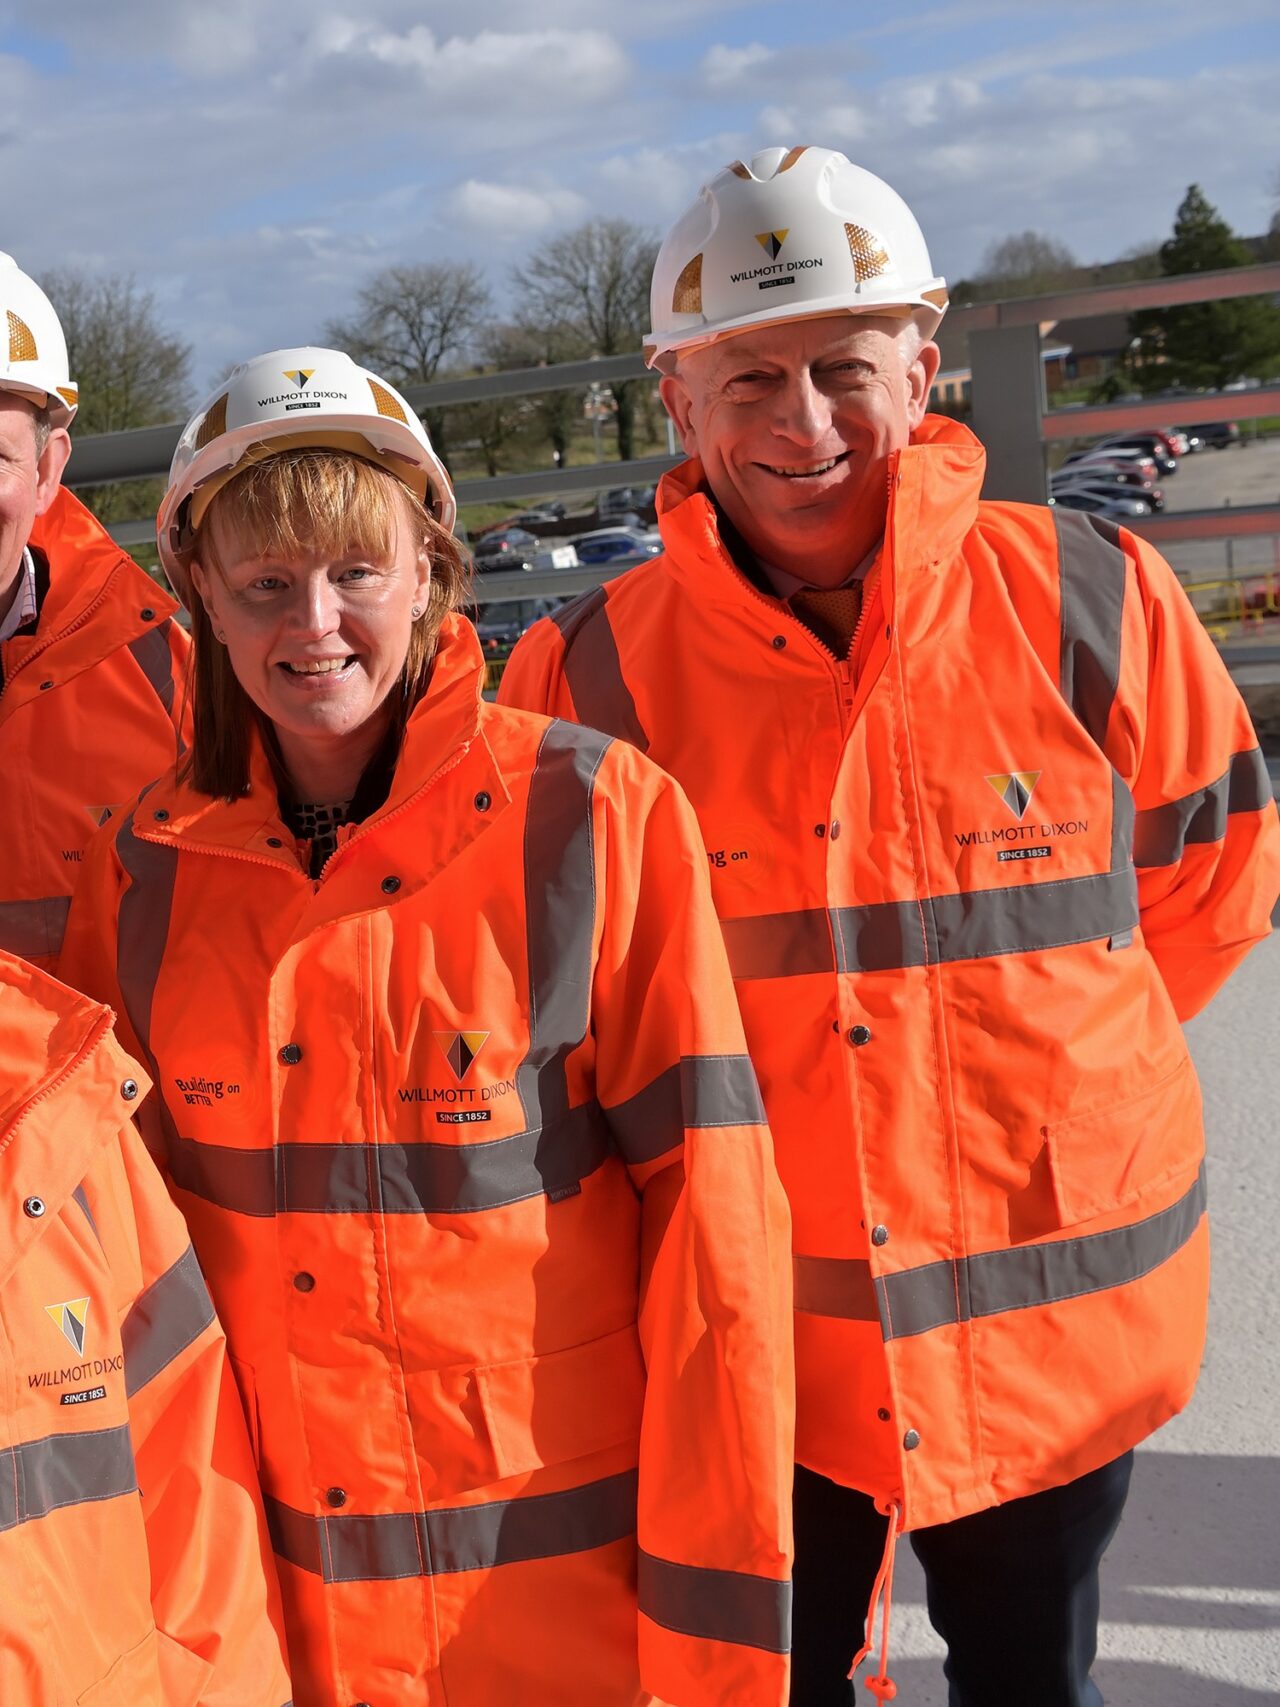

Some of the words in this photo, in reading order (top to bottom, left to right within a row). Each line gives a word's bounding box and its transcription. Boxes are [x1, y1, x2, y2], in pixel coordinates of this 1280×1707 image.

[730, 263, 784, 283] WILLMOTT
[786, 258, 824, 271] DIXON
[257, 391, 311, 407] WILLMOTT
[313, 391, 348, 400] DIXON
[954, 825, 1036, 847] WILLMOTT
[1040, 820, 1089, 837] DIXON
[730, 850, 748, 861] on
[999, 850, 1025, 861] SINCE
[1026, 847, 1048, 858] 1852
[174, 1077, 224, 1099] Building
[227, 1084, 240, 1094] on
[397, 1087, 476, 1103] WILLMOTT
[481, 1079, 516, 1101] DIXON
[184, 1093, 214, 1107] BETTER
[439, 1113, 464, 1123] SINCE
[465, 1111, 488, 1122] 1852
[27, 1362, 93, 1389] WILLMOTT
[93, 1354, 124, 1376] DIXO
[63, 1392, 88, 1404] SINCE
[88, 1387, 105, 1400] 1852
